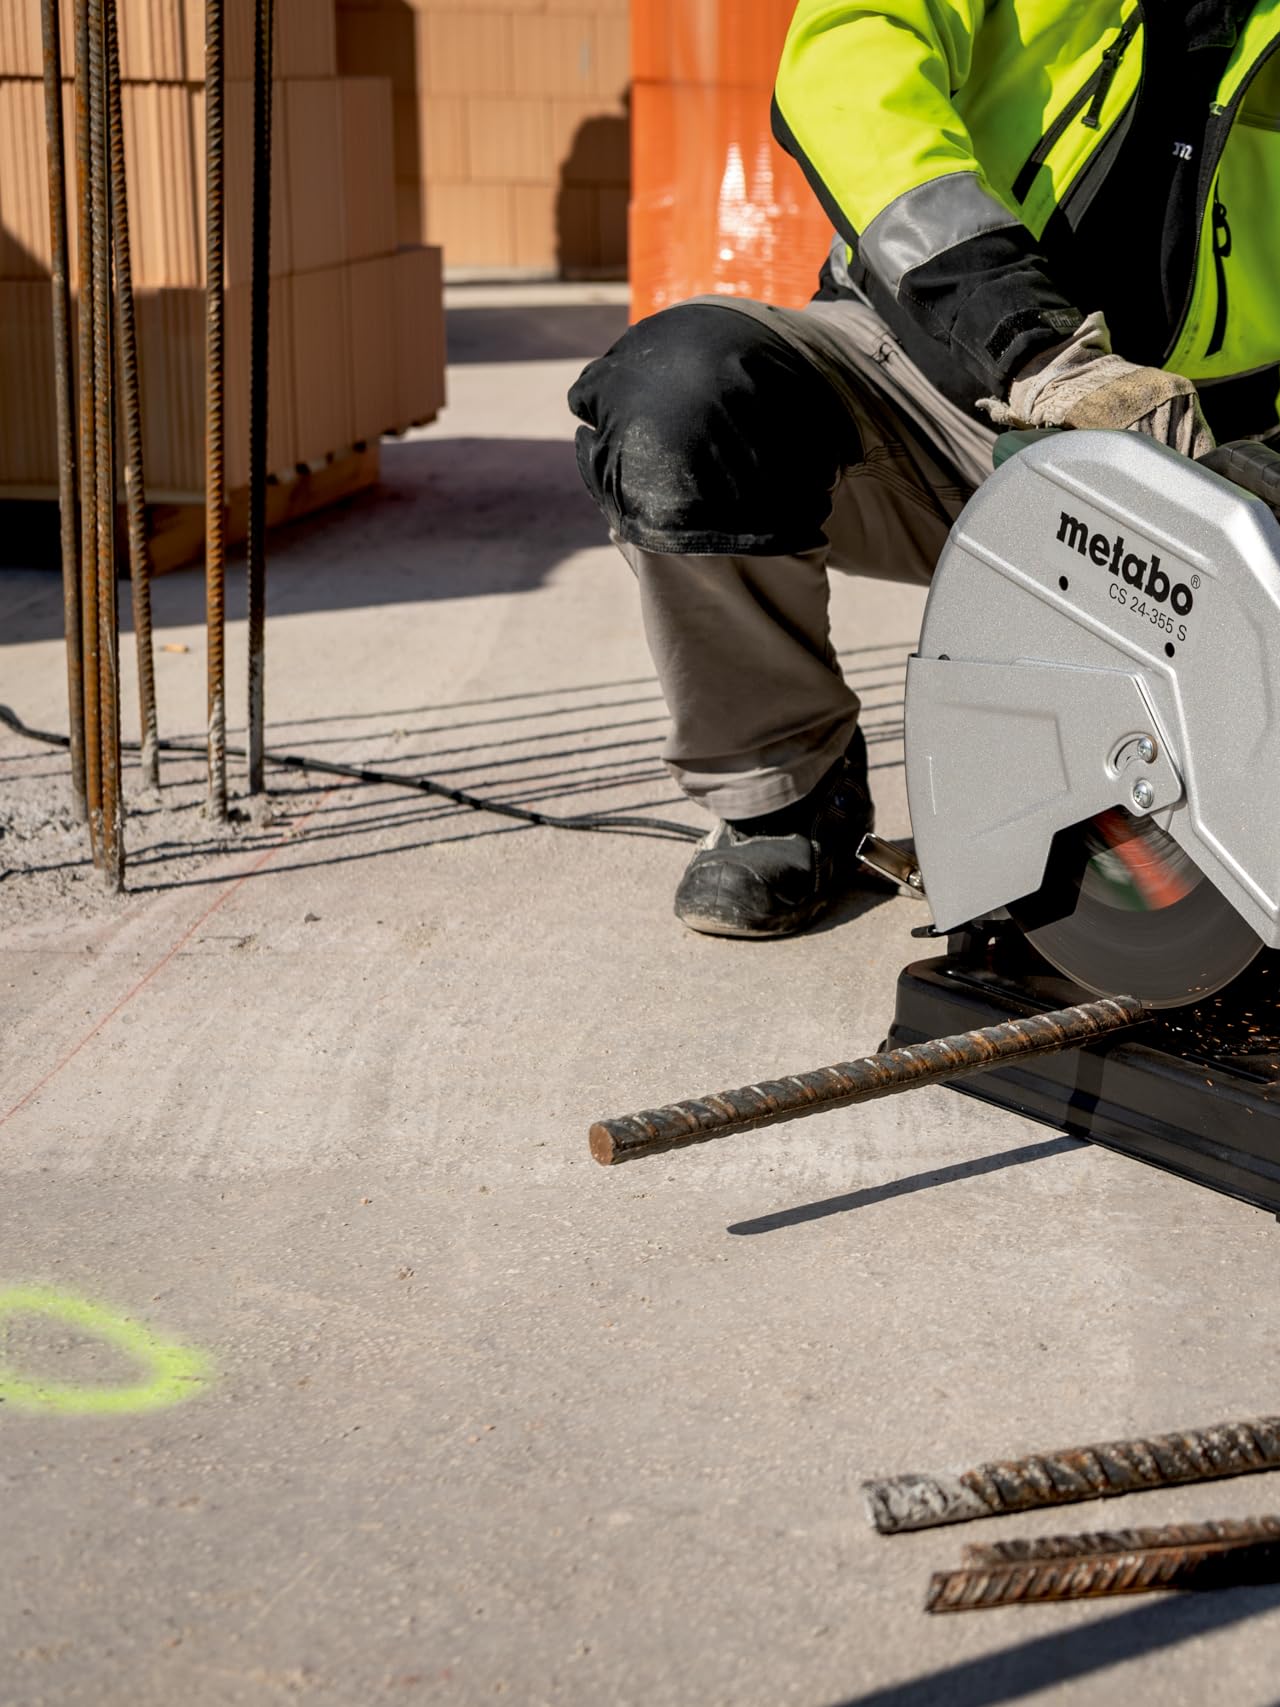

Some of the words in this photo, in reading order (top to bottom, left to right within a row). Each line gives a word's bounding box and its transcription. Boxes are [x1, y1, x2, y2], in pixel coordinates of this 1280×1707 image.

[1109, 583, 1127, 604] CS
[1129, 596, 1174, 634] 24-355
[1177, 624, 1187, 641] S
